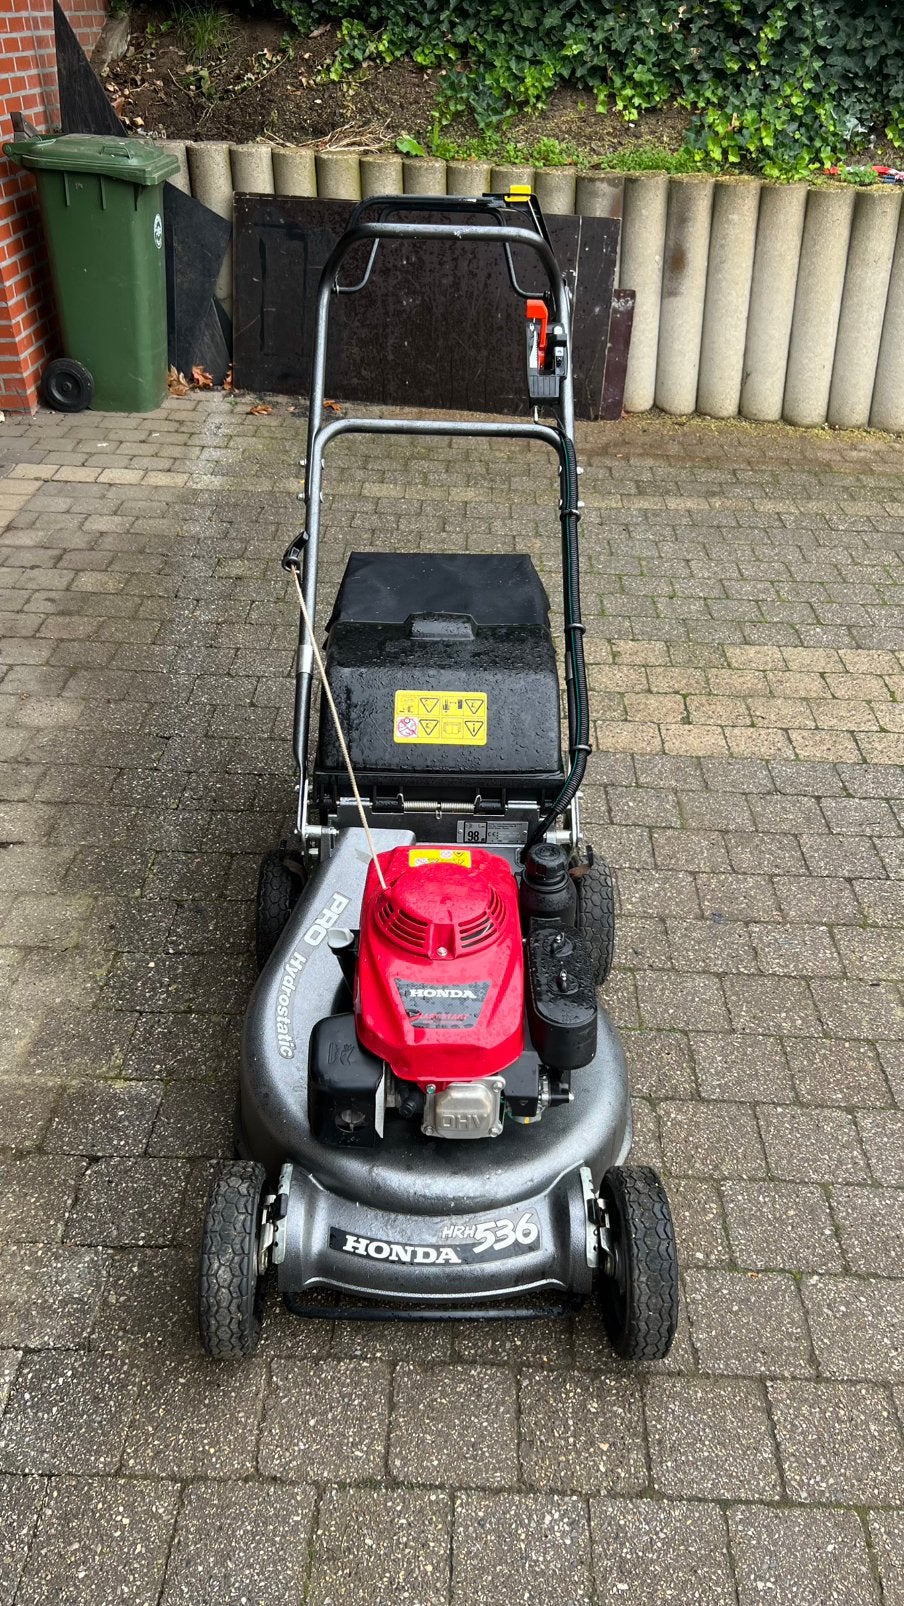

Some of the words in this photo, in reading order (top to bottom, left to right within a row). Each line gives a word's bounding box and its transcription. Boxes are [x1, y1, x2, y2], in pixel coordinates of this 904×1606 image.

[467, 830, 480, 842] 98
[303, 892, 351, 946] PRO
[276, 951, 307, 1060] Hydrostatic
[409, 988, 477, 998] HONDA
[342, 1234, 461, 1264] HONDA
